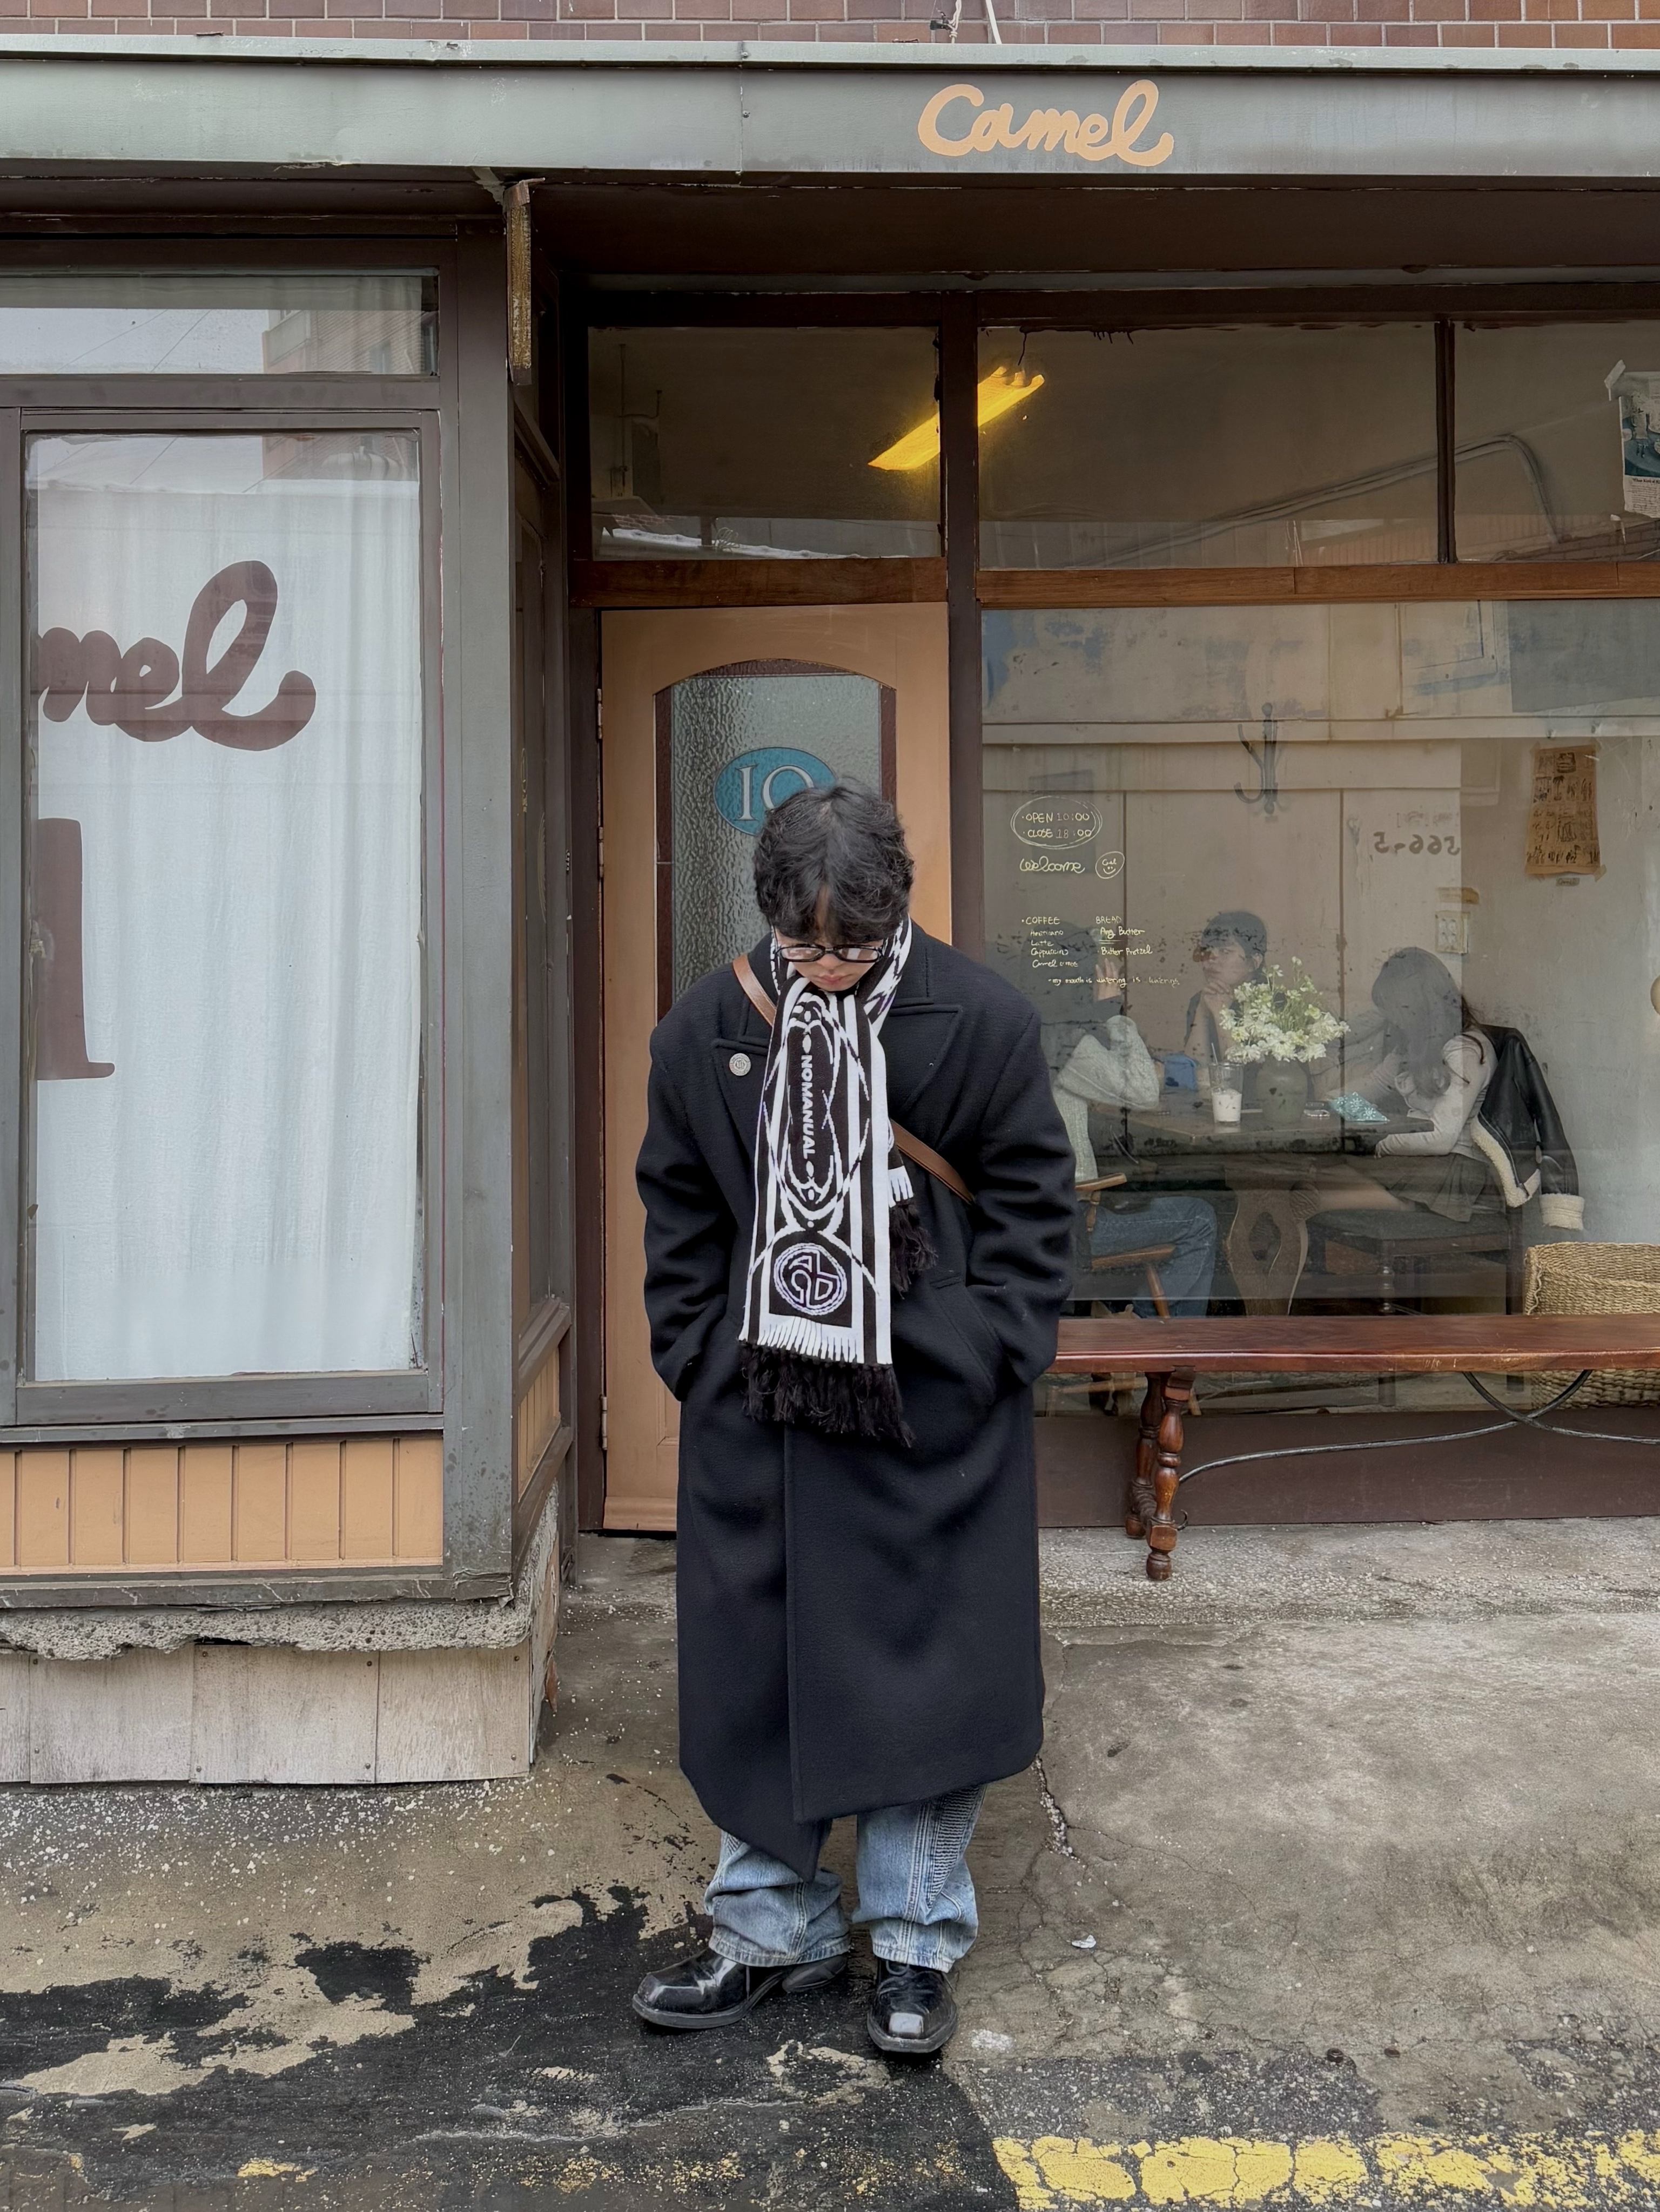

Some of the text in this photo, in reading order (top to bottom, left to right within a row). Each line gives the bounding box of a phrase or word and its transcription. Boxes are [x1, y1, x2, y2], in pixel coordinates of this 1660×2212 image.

[917, 78, 1174, 167] Camel
[1025, 812, 1090, 824] OPEN 10:00
[1027, 829, 1053, 838] CLOSE
[1025, 916, 1060, 925] COFFEE
[1096, 915, 1122, 924] BREAD
[1118, 926, 1146, 936] Butter
[1101, 946, 1124, 955] Butter
[801, 1055, 816, 1160] NOMANUAL
